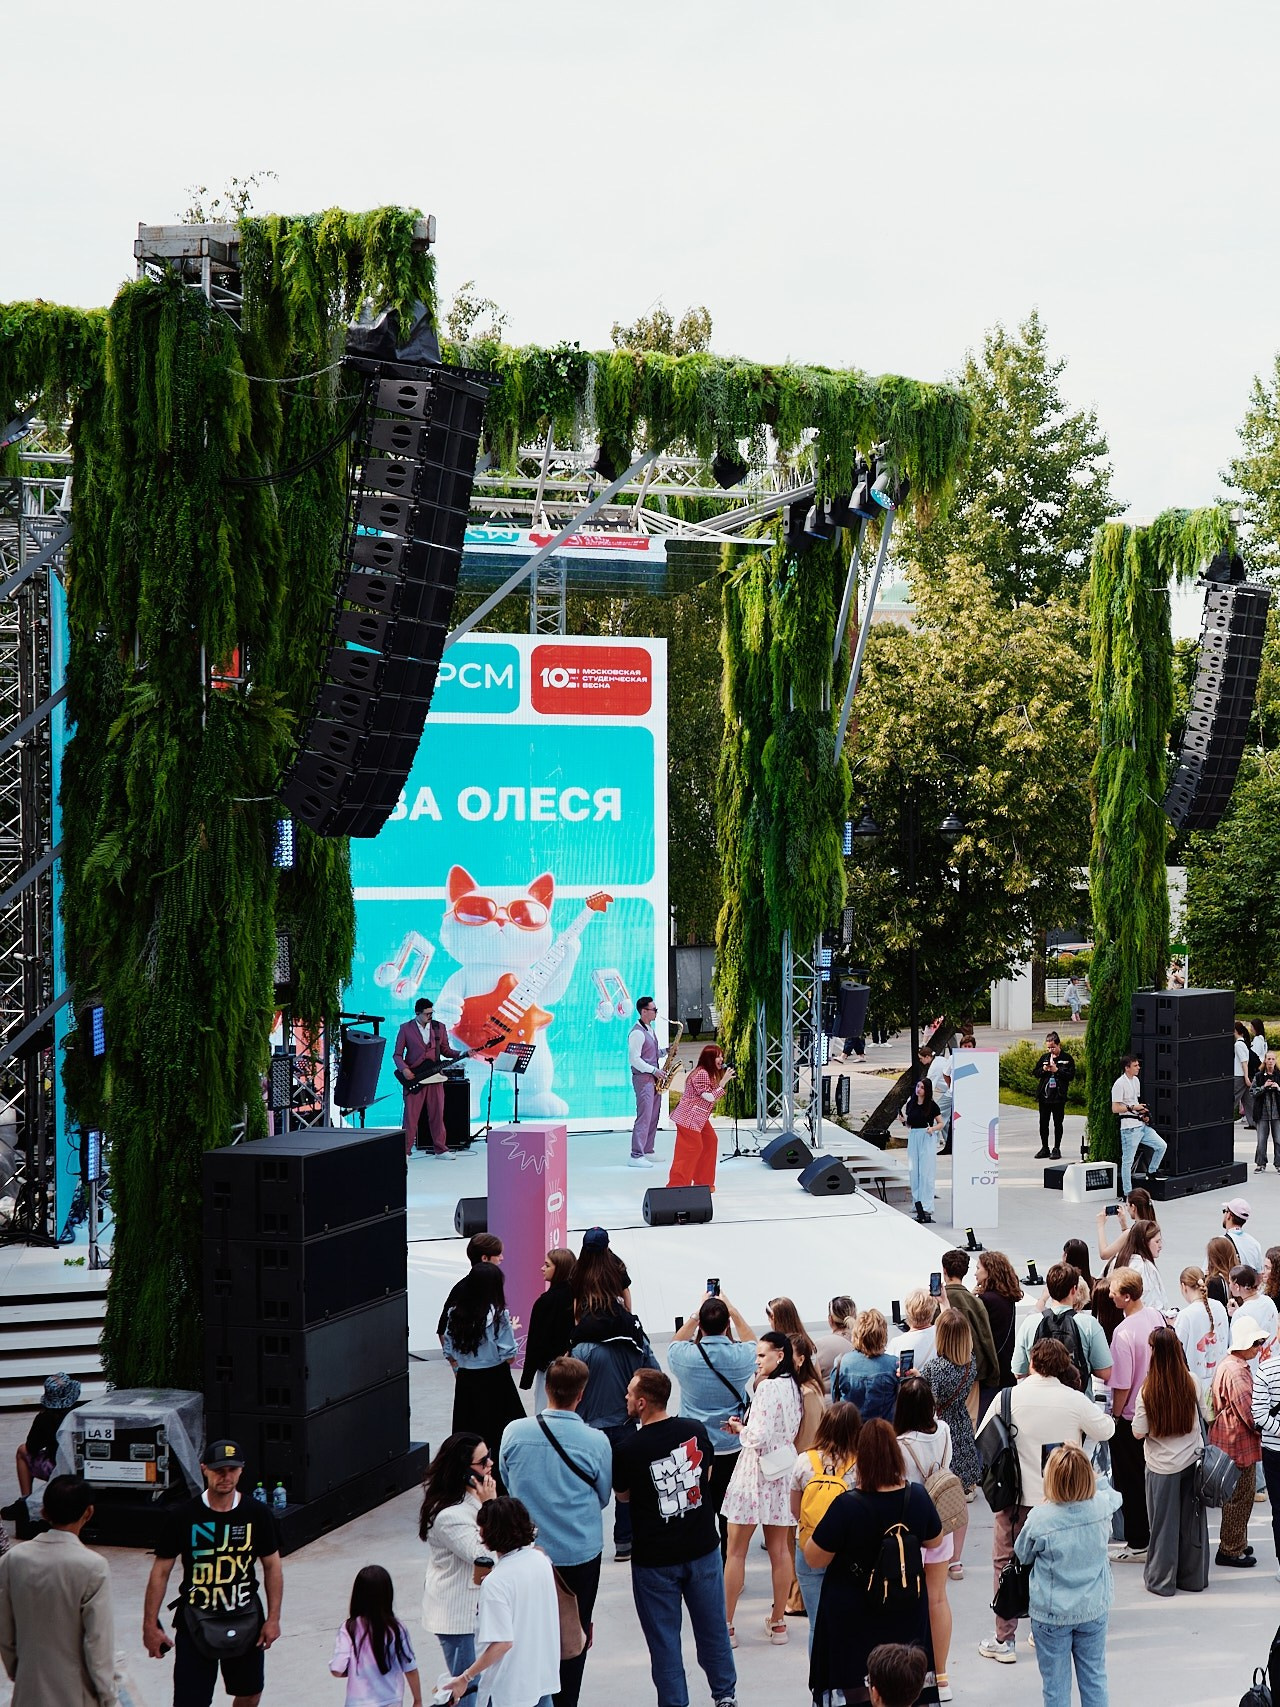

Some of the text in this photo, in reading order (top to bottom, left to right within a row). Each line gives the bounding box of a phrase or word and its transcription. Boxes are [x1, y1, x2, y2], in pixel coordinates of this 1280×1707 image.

[457, 786, 622, 821] ОЛЕСЯ
[88, 1429, 112, 1438] LA 8
